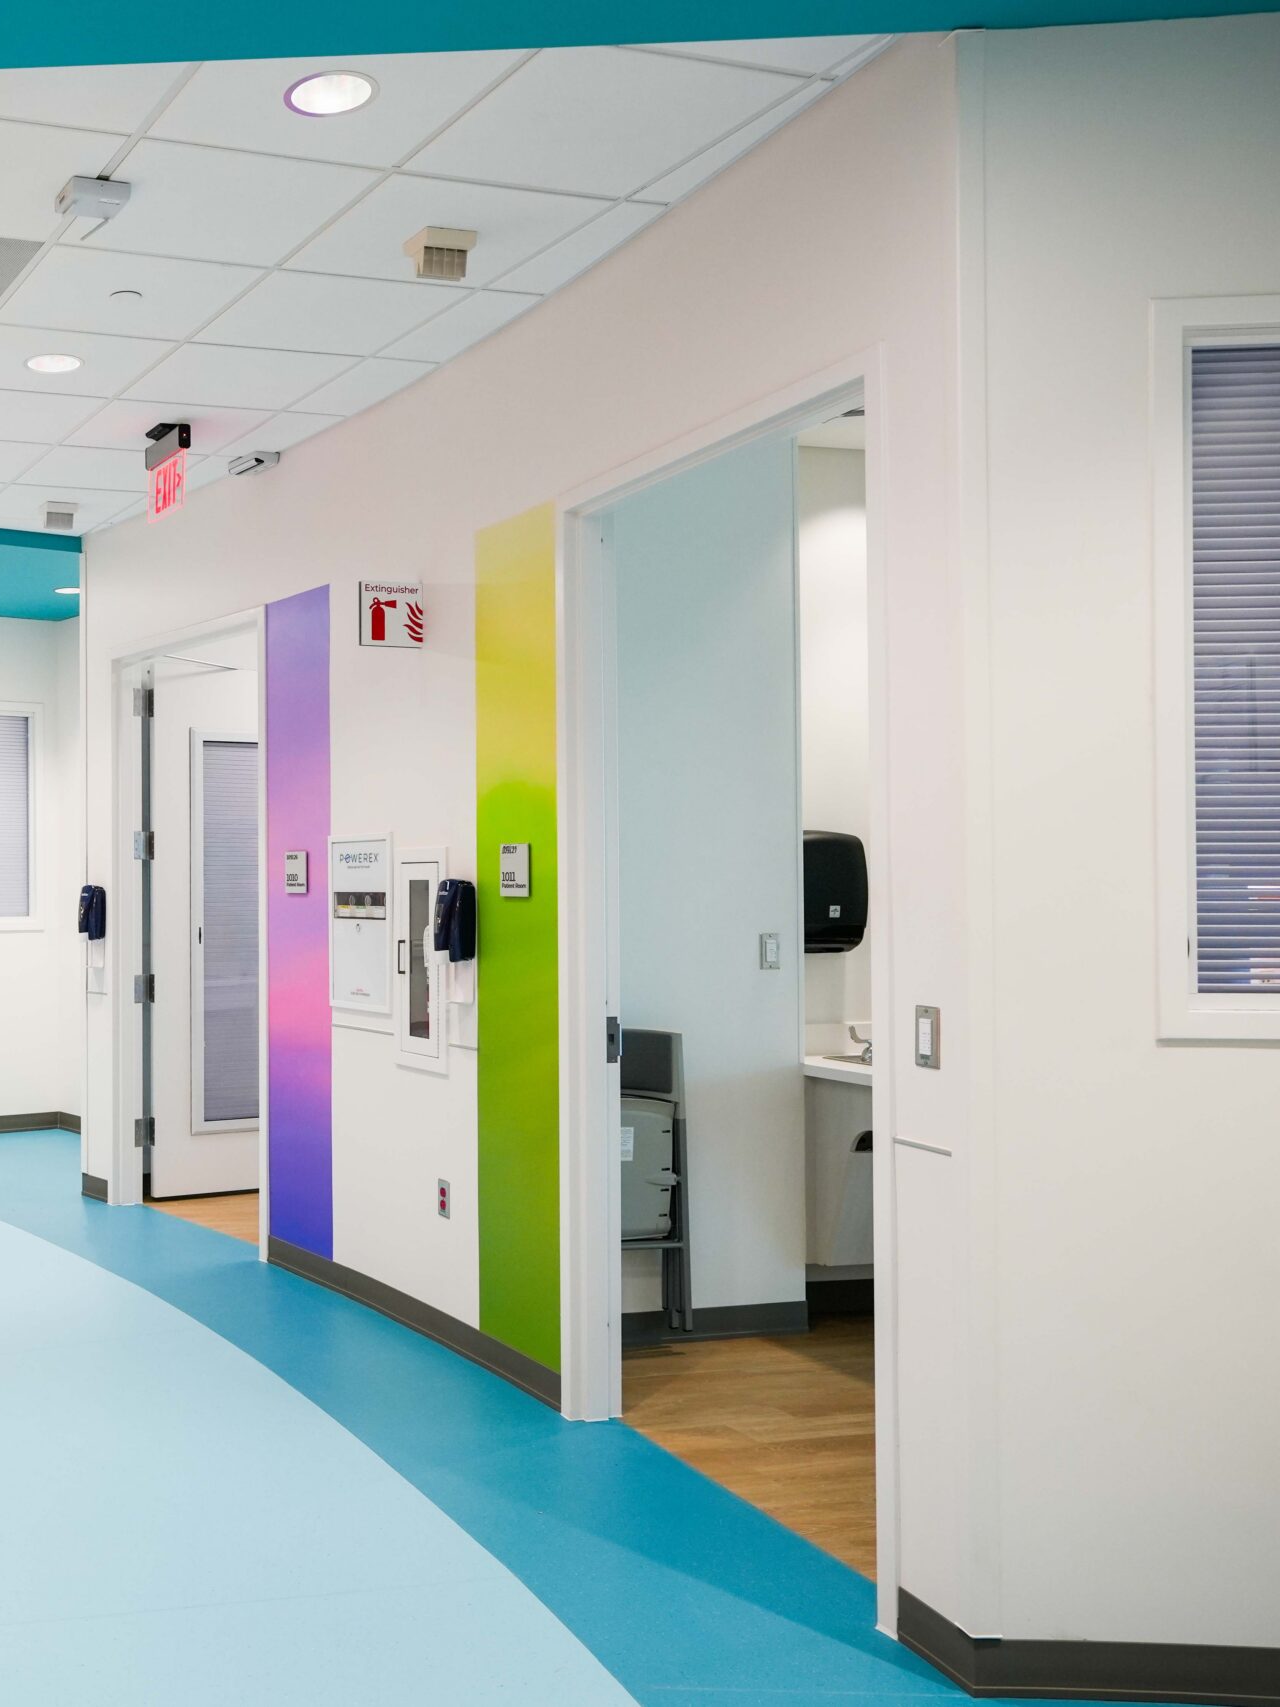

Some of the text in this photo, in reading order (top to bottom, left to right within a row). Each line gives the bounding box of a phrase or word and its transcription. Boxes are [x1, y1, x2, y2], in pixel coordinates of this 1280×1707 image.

[155, 458, 178, 514] EXIT
[364, 583, 419, 595] Extinguisher
[339, 853, 379, 863] POWEREX
[501, 872, 516, 882] 1011
